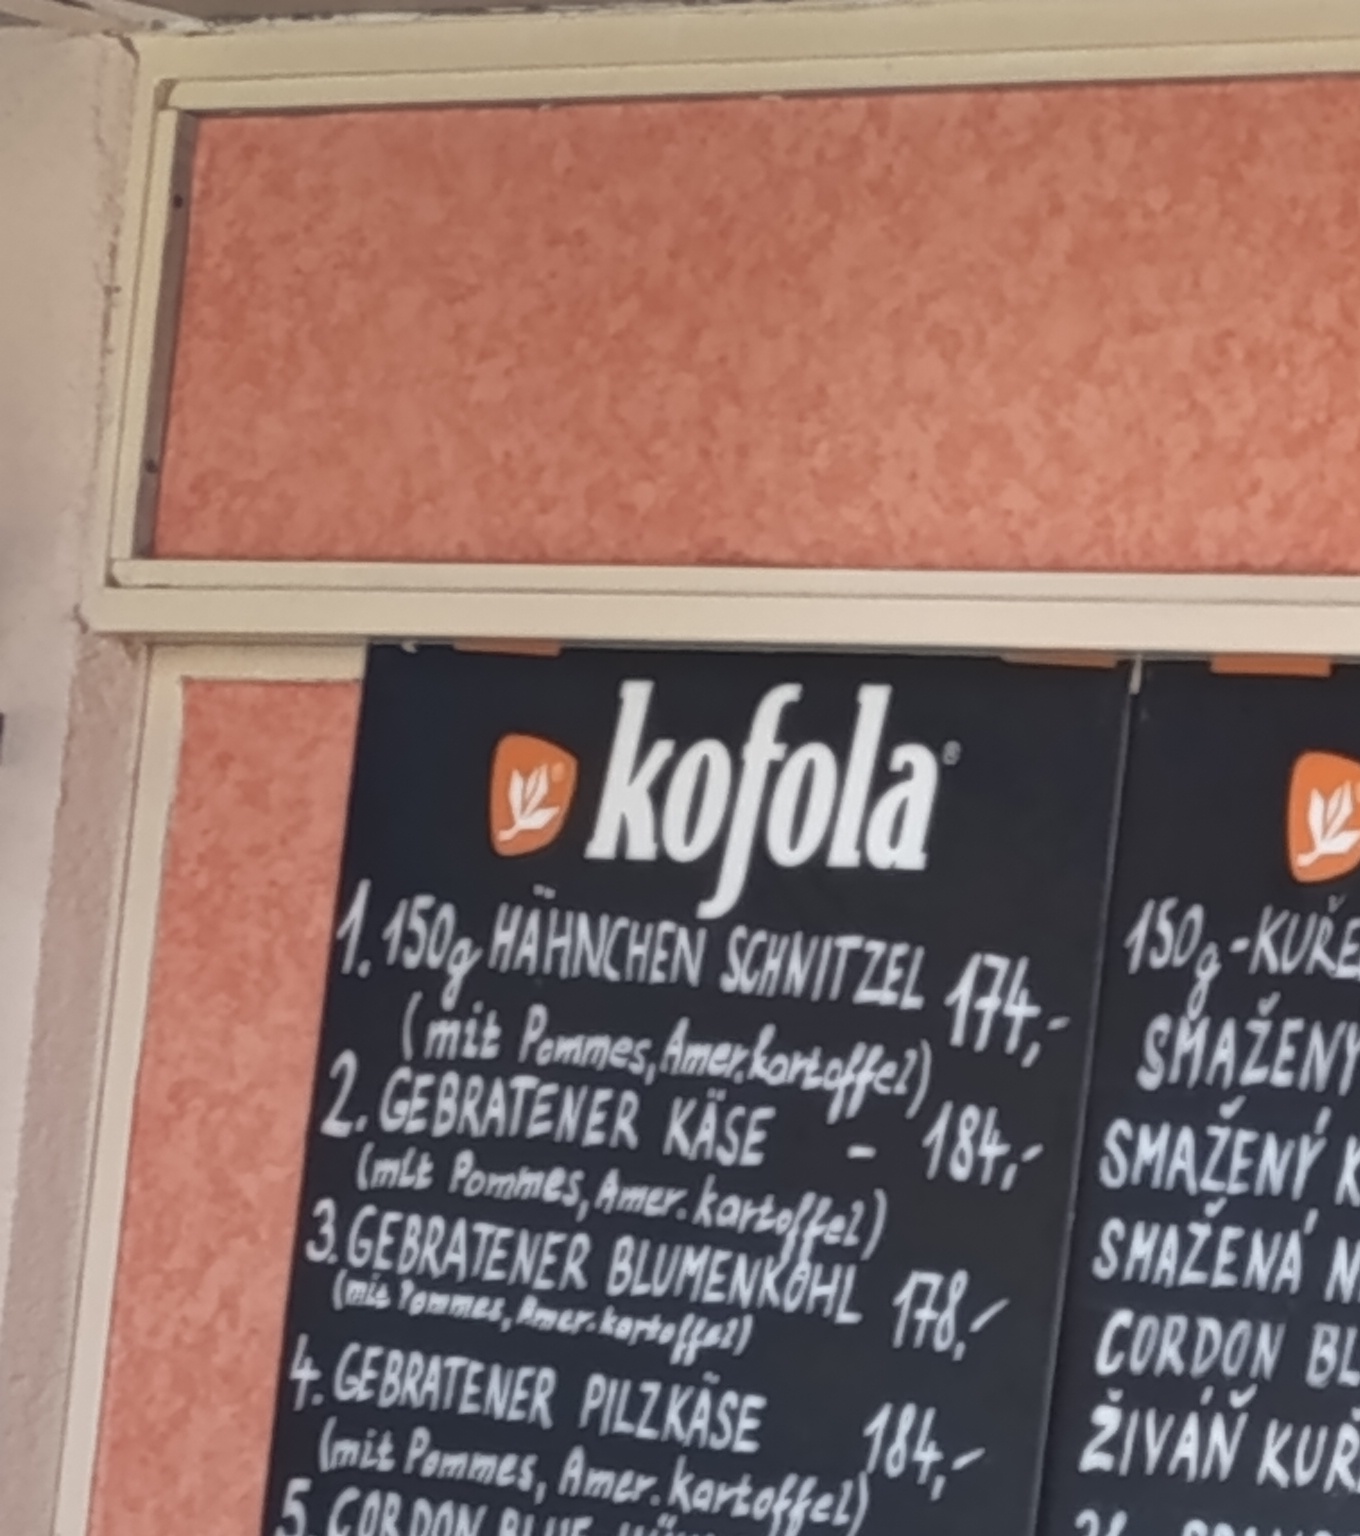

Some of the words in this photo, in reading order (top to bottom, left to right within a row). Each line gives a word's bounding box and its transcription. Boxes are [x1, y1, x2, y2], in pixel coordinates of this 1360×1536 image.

[584, 679, 939, 920] kofola
[383, 894, 483, 1011] 150g
[489, 884, 707, 986] HÄHNCHEN
[721, 925, 925, 1011] SCHNITZEL
[321, 1050, 367, 1138] 2.
[380, 1067, 638, 1150] GEBRATENER
[664, 1091, 775, 1166] KÄSE
[1100, 1097, 1332, 1197] SMAŽENÝ
[346, 1205, 590, 1291] GEBRATENER
[608, 1236, 863, 1327] BLUMENKOHL
[1093, 1200, 1318, 1294] SMAŽENÁ
[334, 1343, 556, 1429] GEBRATENER
[579, 1371, 767, 1453] PILZKÄSE
[1095, 1309, 1286, 1380] CORDON
[1079, 1385, 1258, 1477] ŽIVÁŇ
